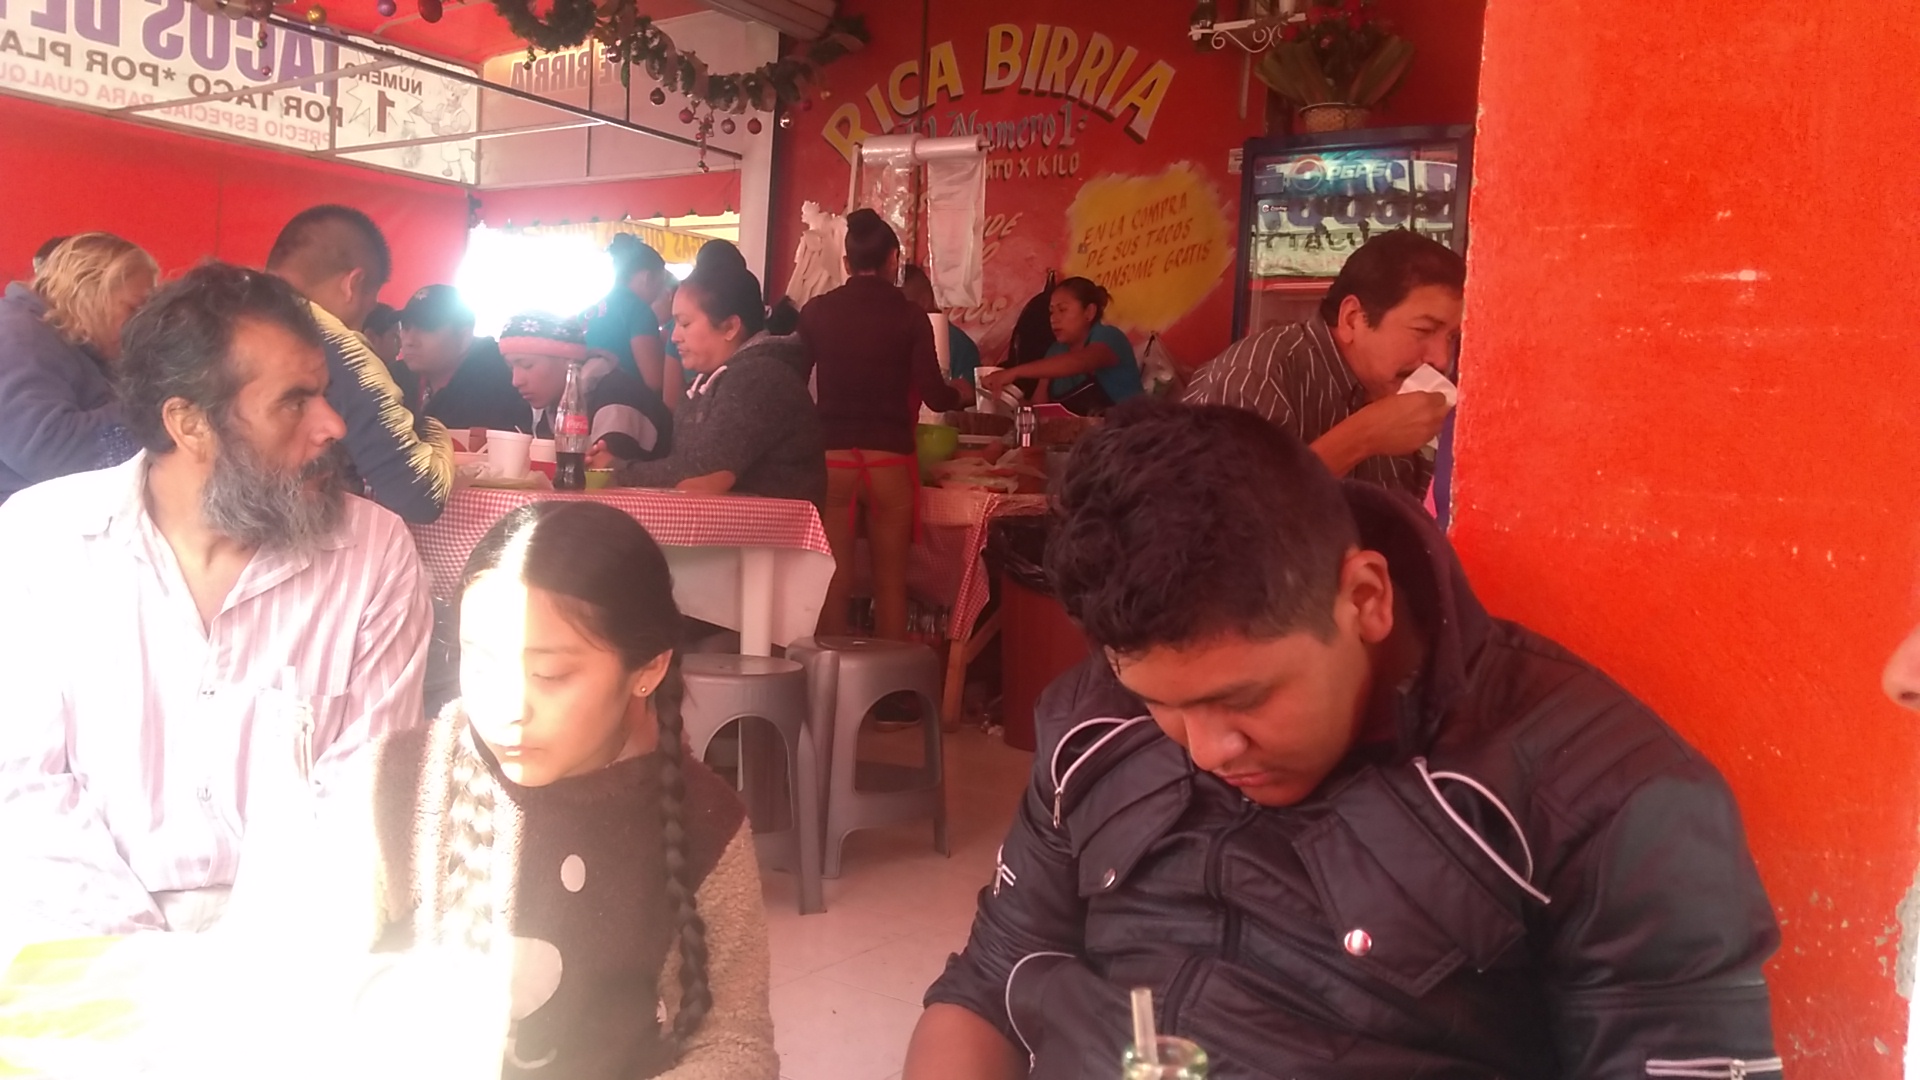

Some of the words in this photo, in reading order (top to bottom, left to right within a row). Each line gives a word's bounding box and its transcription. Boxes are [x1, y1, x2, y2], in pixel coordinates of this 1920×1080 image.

[820, 41, 964, 165] RICA
[984, 23, 1176, 142] BIRRIA
[1019, 157, 1032, 178] X
[1037, 152, 1080, 177] KILO
[1083, 222, 1107, 247] EN
[1109, 215, 1125, 239] LA
[1131, 192, 1187, 231] COMPRA
[1086, 245, 1109, 269] DE
[1113, 235, 1140, 261] SUS
[1146, 217, 1194, 248] TACOS
[1164, 239, 1213, 274] GRATIS
